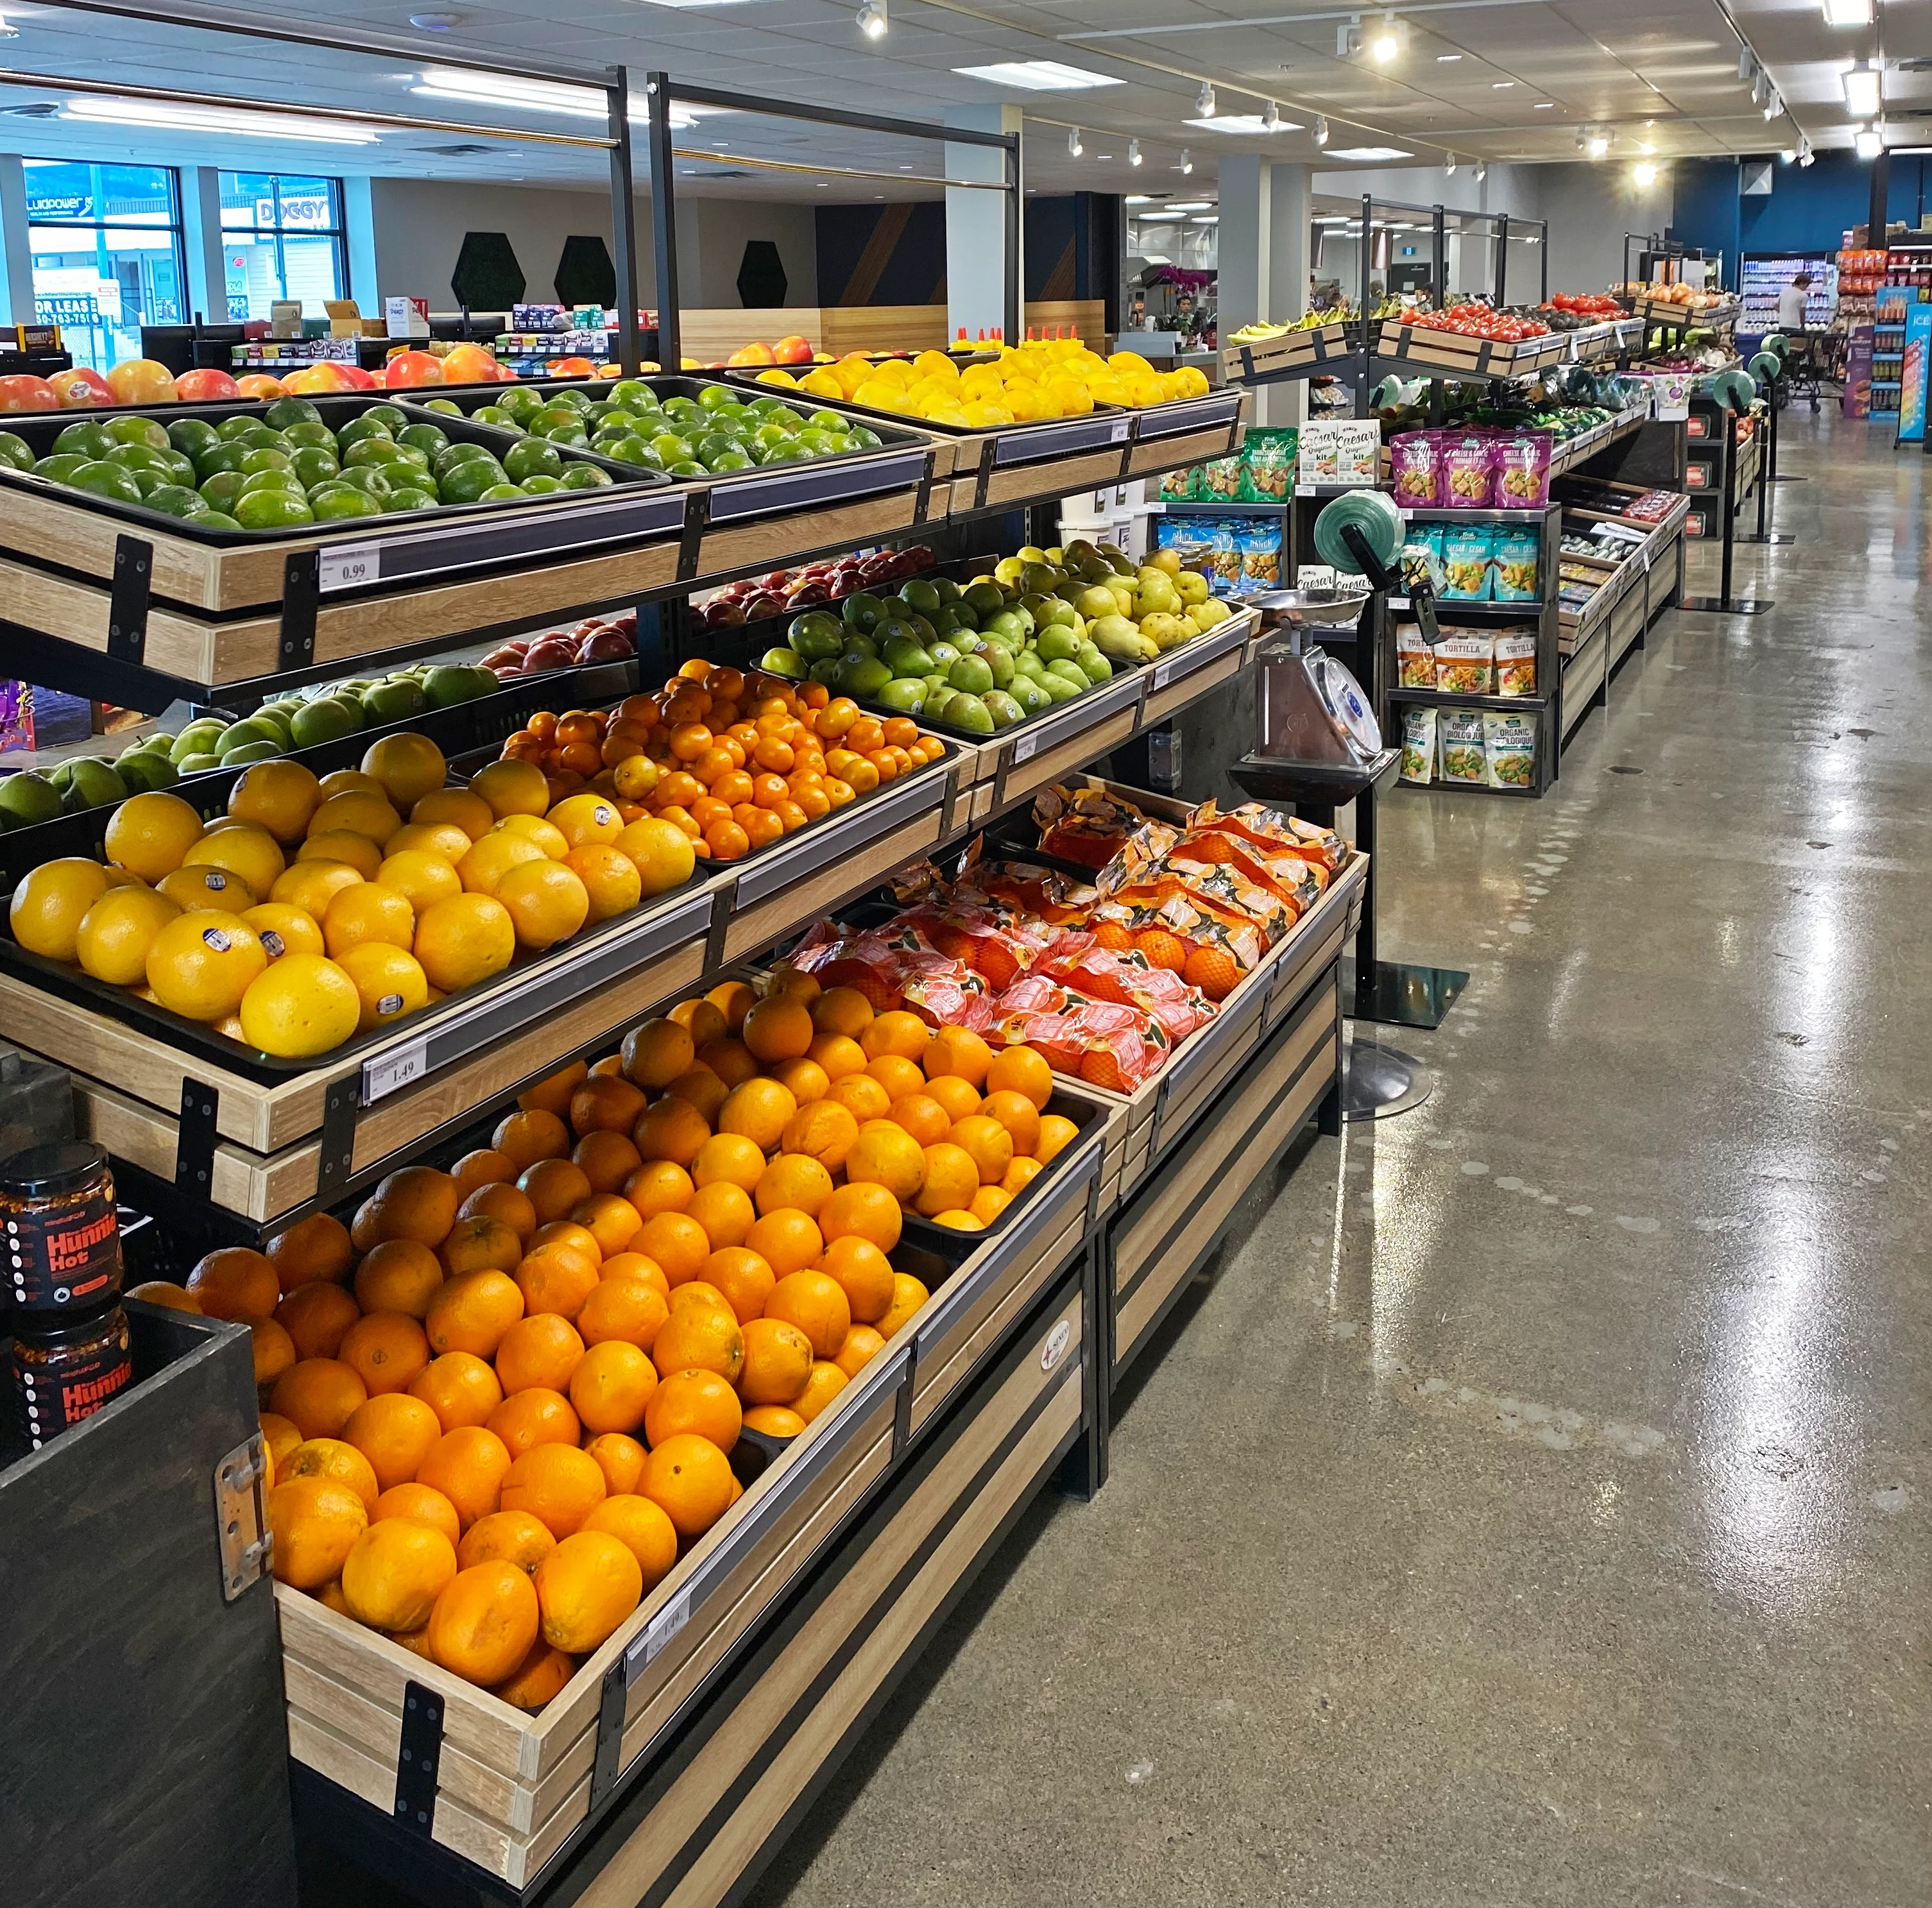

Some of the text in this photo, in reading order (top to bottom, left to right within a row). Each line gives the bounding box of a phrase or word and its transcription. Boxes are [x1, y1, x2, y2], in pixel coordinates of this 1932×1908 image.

[1299, 431, 1337, 450] Caesar
[1337, 430, 1375, 450] Caesar
[1446, 544, 1466, 552] CAESAR
[343, 564, 365, 580] 0.99
[1297, 575, 1333, 589] Caesar
[1336, 578, 1372, 589] Caesar
[1444, 644, 1480, 652] TORTILLA
[1500, 728, 1530, 737] ORGANIC
[393, 1061, 414, 1082] 1.49
[49, 1250, 89, 1272] Hot
